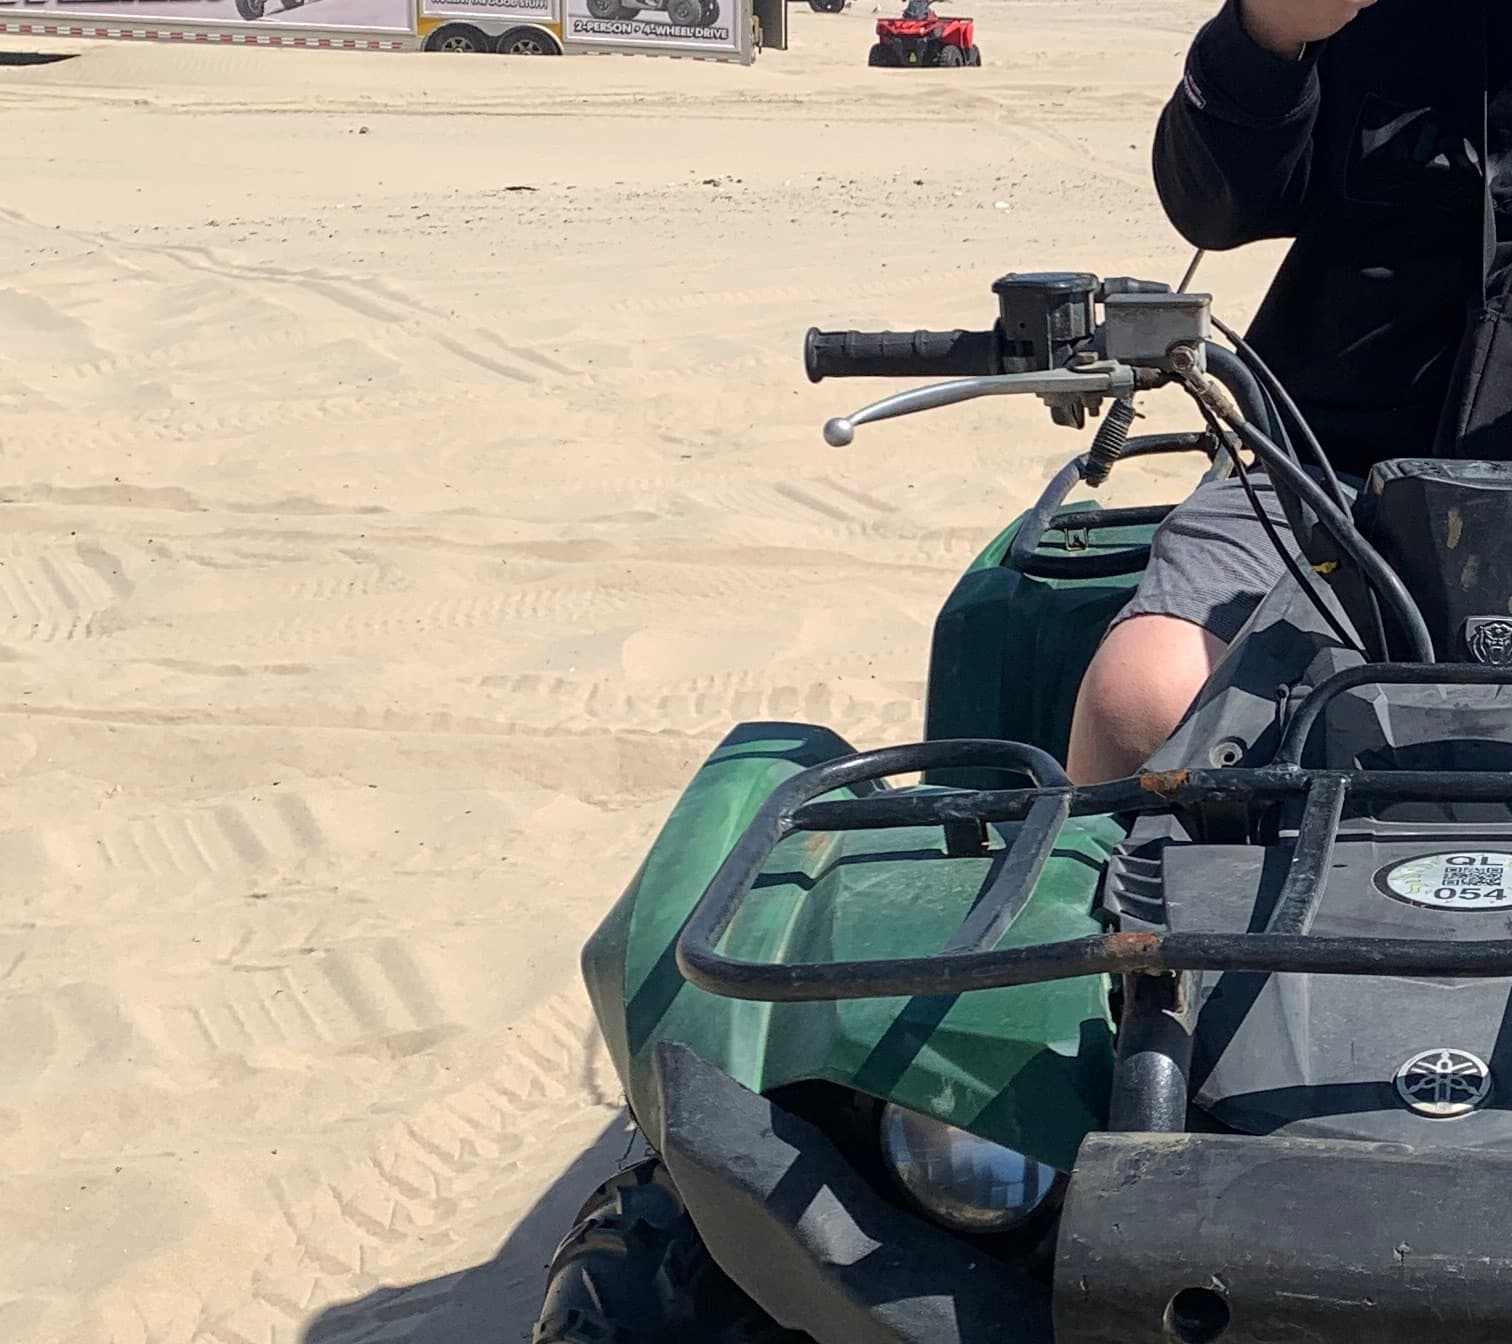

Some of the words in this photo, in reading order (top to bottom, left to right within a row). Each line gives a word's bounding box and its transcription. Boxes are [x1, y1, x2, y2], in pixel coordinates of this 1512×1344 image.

[574, 20, 632, 34] 2-PERSON
[642, 23, 694, 37] 4-WHEEL
[694, 27, 728, 39] DRIVE
[1445, 855, 1504, 867] QL
[1433, 887, 1507, 901] 054
